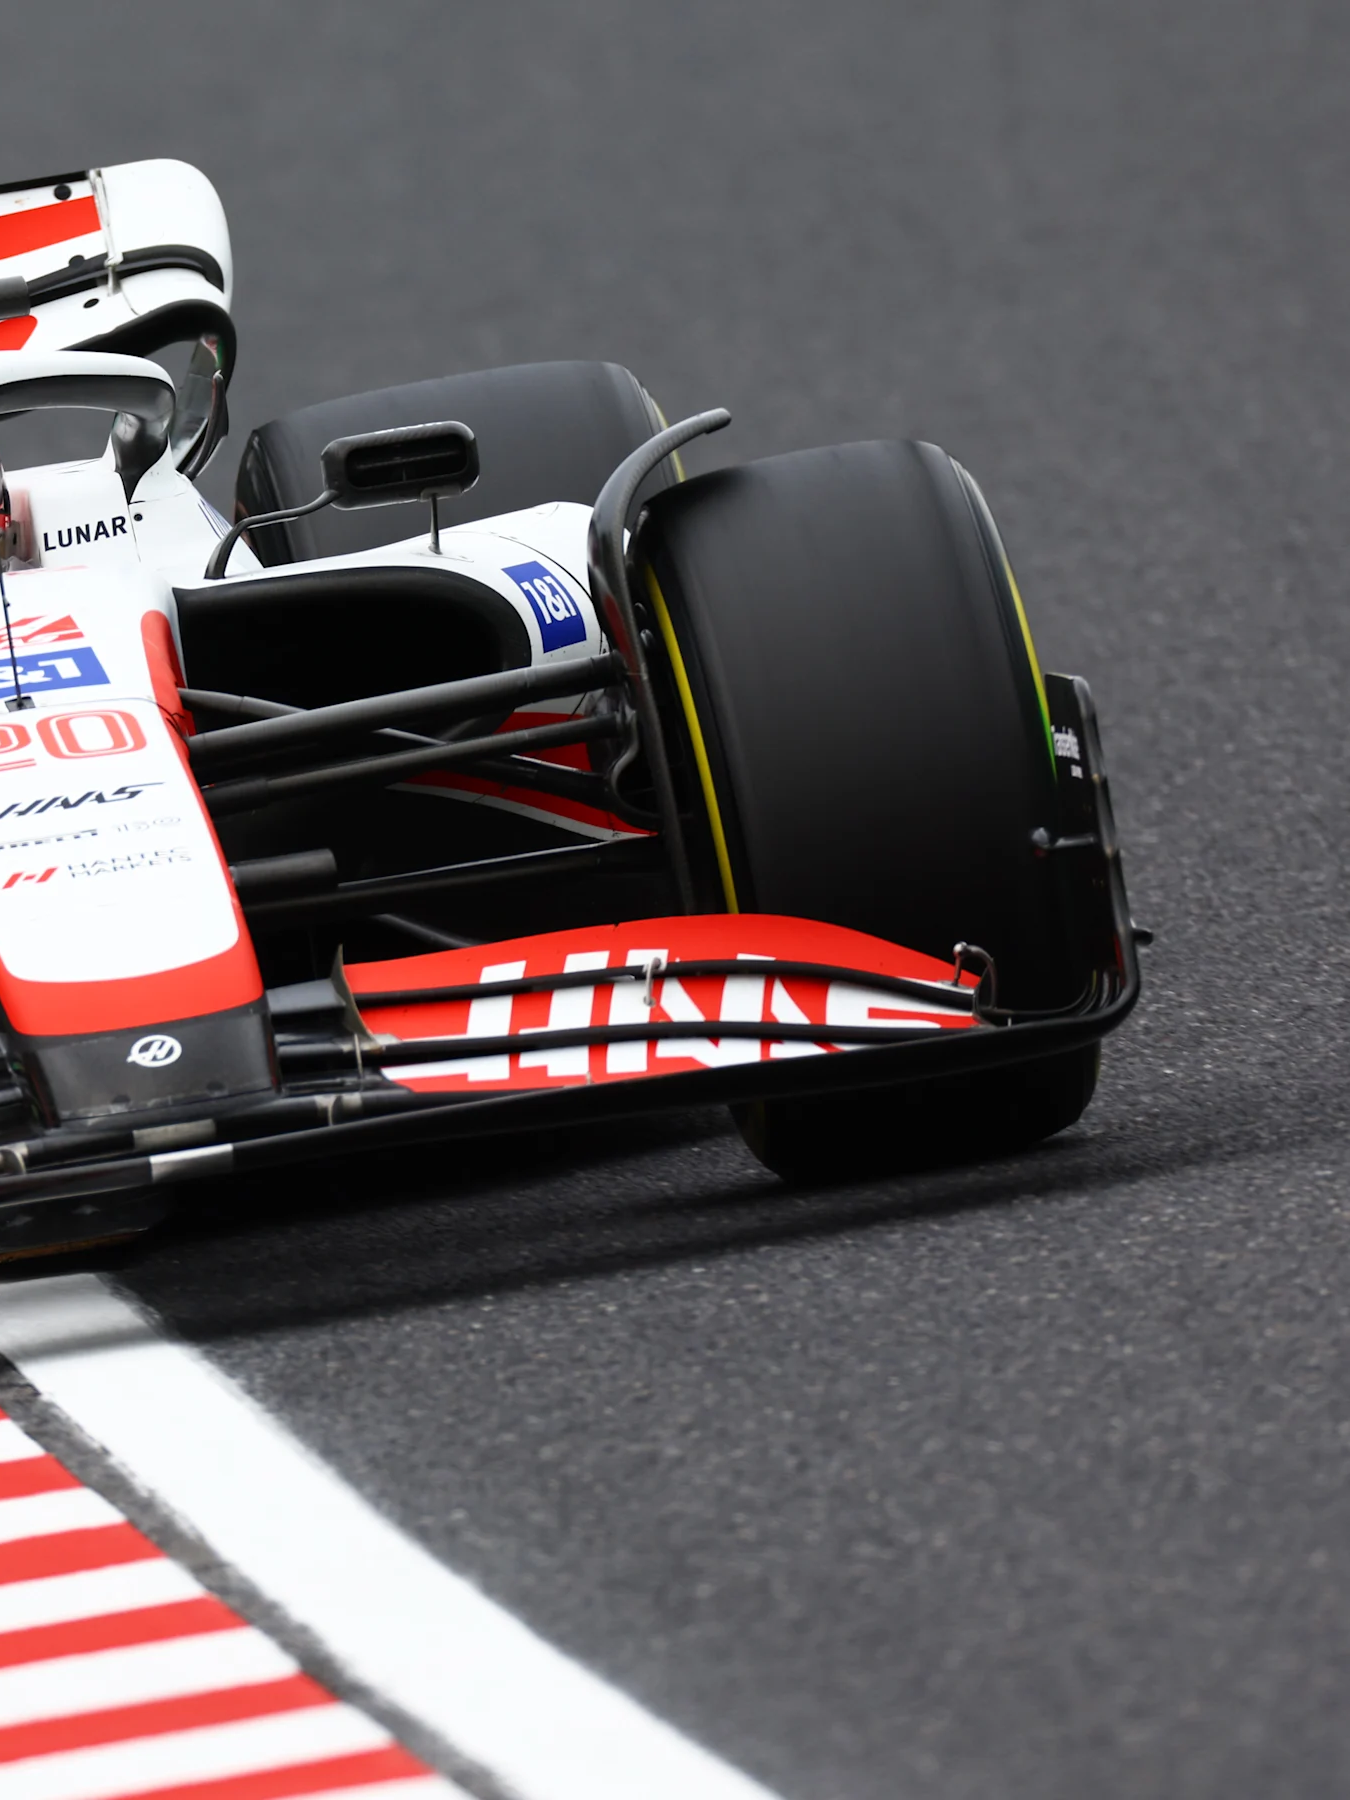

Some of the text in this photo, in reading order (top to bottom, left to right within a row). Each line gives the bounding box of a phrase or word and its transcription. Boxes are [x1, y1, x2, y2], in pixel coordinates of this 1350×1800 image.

[43, 515, 128, 551] LUNAR
[519, 575, 578, 625] 1&1
[67, 846, 190, 871] HANTEC
